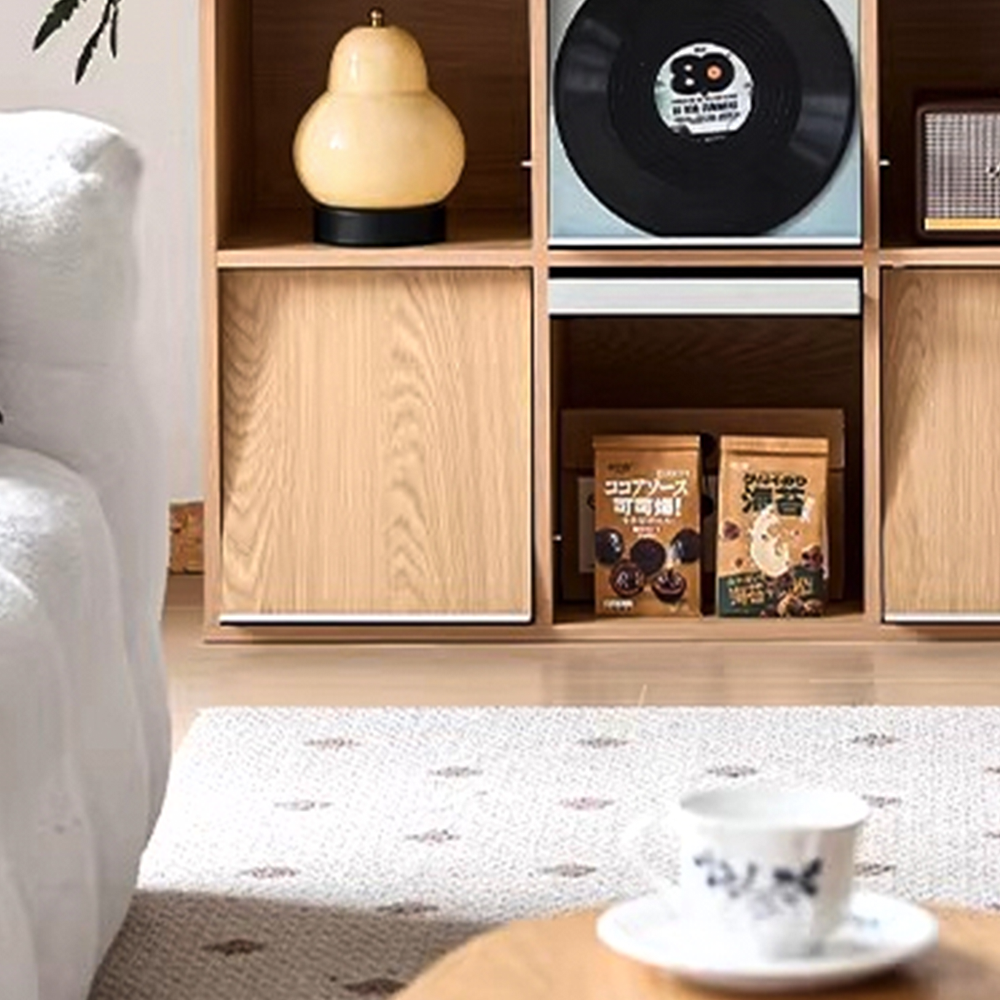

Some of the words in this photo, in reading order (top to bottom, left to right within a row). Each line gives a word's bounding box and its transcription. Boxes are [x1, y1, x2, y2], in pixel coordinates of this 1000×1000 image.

[604, 479, 689, 498] ココアソース
